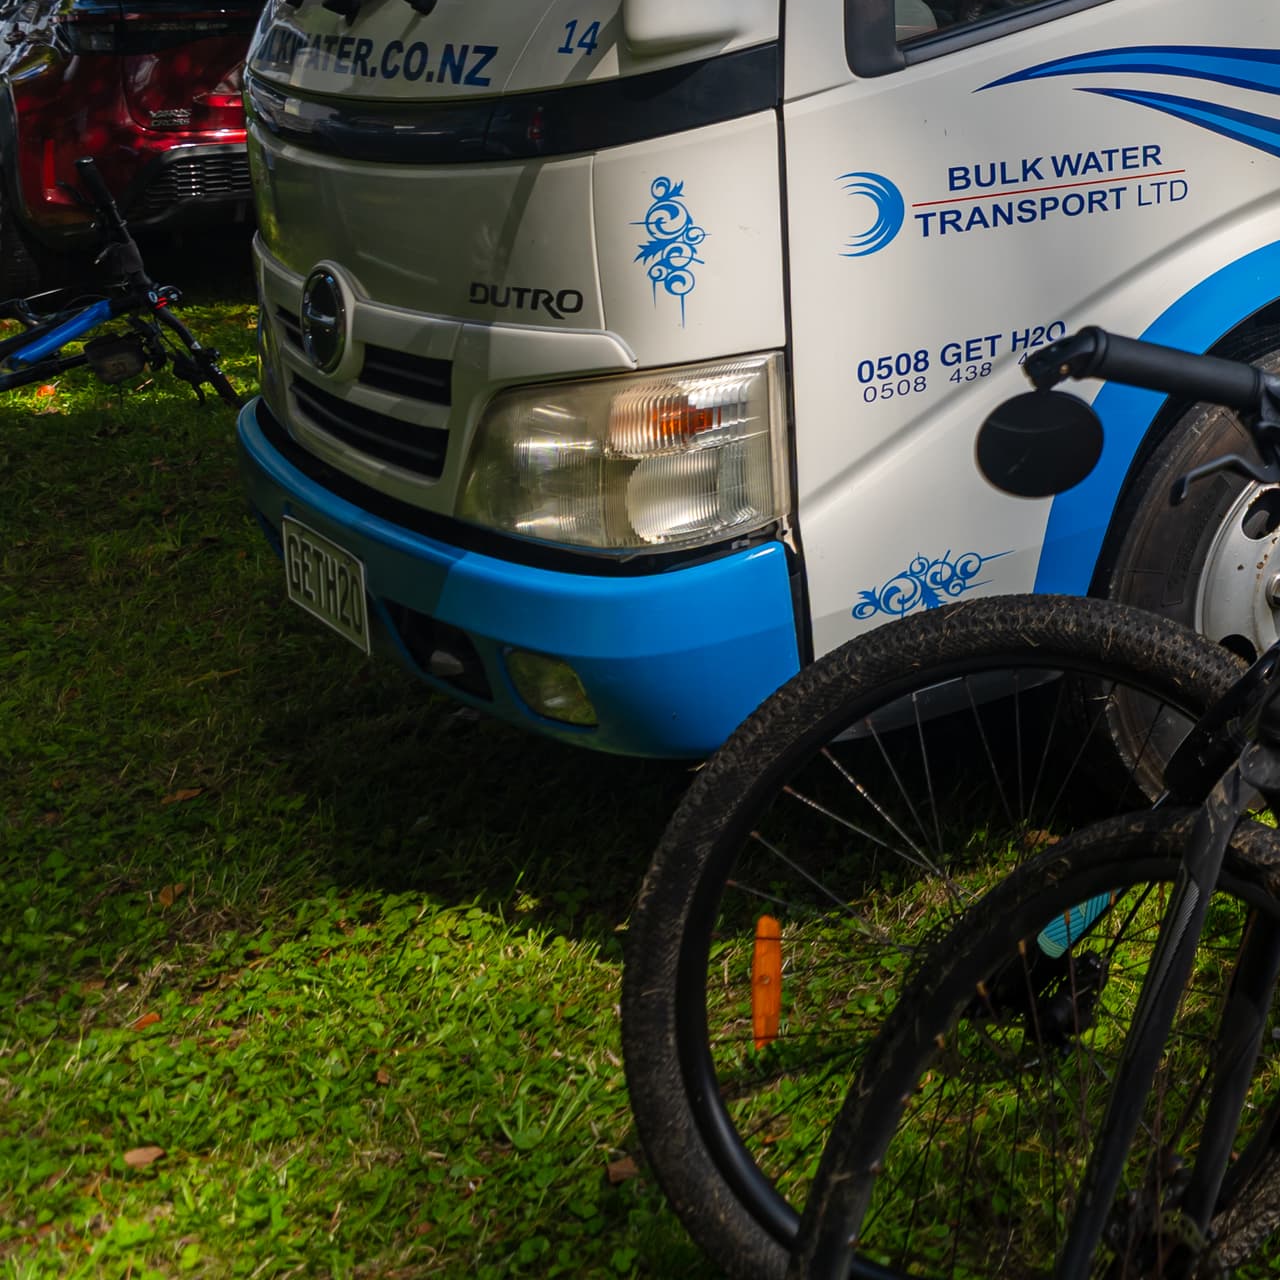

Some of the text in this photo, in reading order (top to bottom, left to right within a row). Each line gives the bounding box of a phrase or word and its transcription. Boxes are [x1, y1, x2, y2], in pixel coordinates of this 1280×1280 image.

[557, 19, 602, 56] 14
[948, 144, 1162, 191] BULK WATER
[914, 179, 1189, 237] TRANSPORT LTD
[469, 282, 583, 320] DUTRO
[857, 349, 930, 384] 0508
[940, 334, 1003, 367] GET
[1011, 320, 1067, 353] H2O
[863, 361, 993, 403] 0508 438
